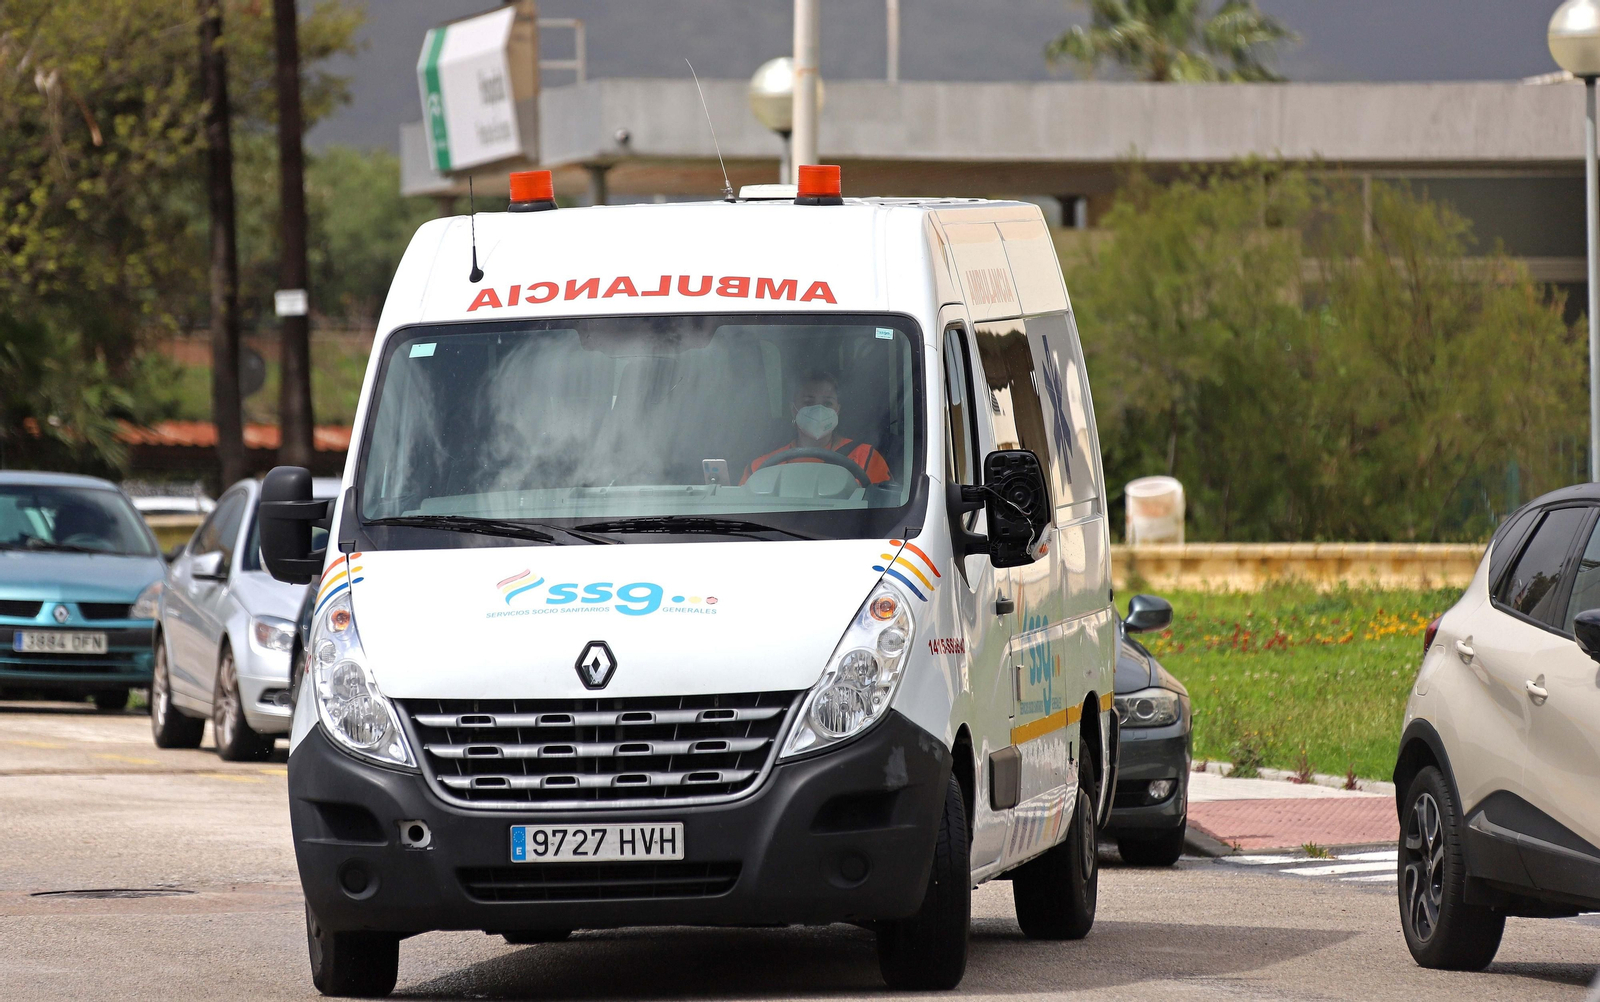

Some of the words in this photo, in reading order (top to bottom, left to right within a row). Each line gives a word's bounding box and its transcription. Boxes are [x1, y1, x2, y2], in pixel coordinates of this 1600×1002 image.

[546, 582, 664, 616] ssg
[486, 609, 530, 618] SERVICIOS
[560, 606, 610, 614] SANITARIOS
[662, 606, 717, 615] GENERALES
[516, 847, 523, 855] E
[532, 828, 608, 857] 9727
[619, 827, 676, 856] HVH
